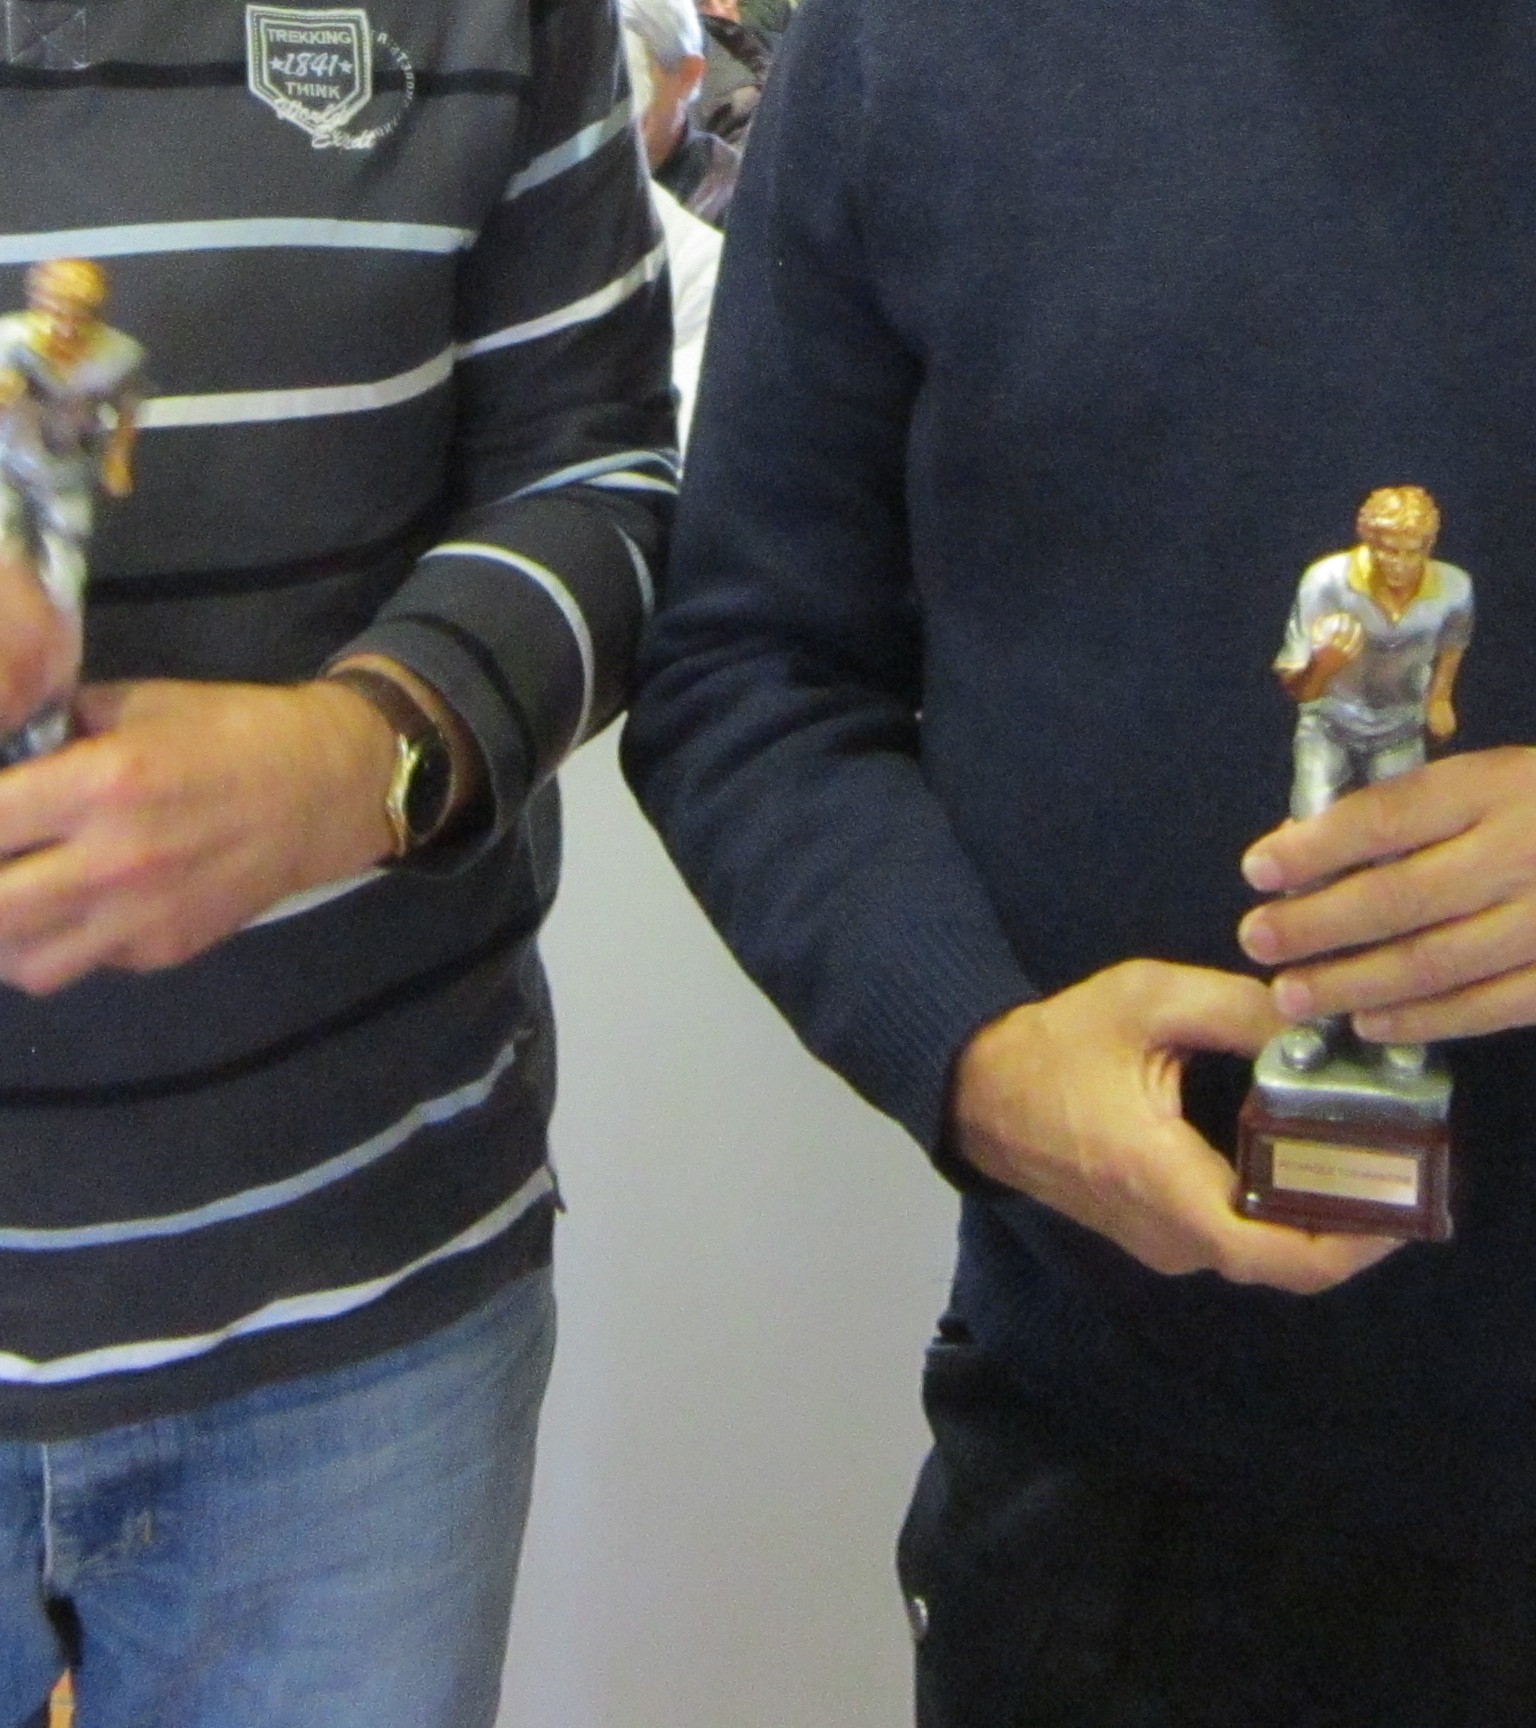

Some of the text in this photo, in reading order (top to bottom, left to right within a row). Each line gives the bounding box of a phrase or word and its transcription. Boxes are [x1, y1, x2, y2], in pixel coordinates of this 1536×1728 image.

[268, 28, 353, 45] TREKKING
[284, 52, 339, 77] 1841
[285, 81, 341, 100] THINK
